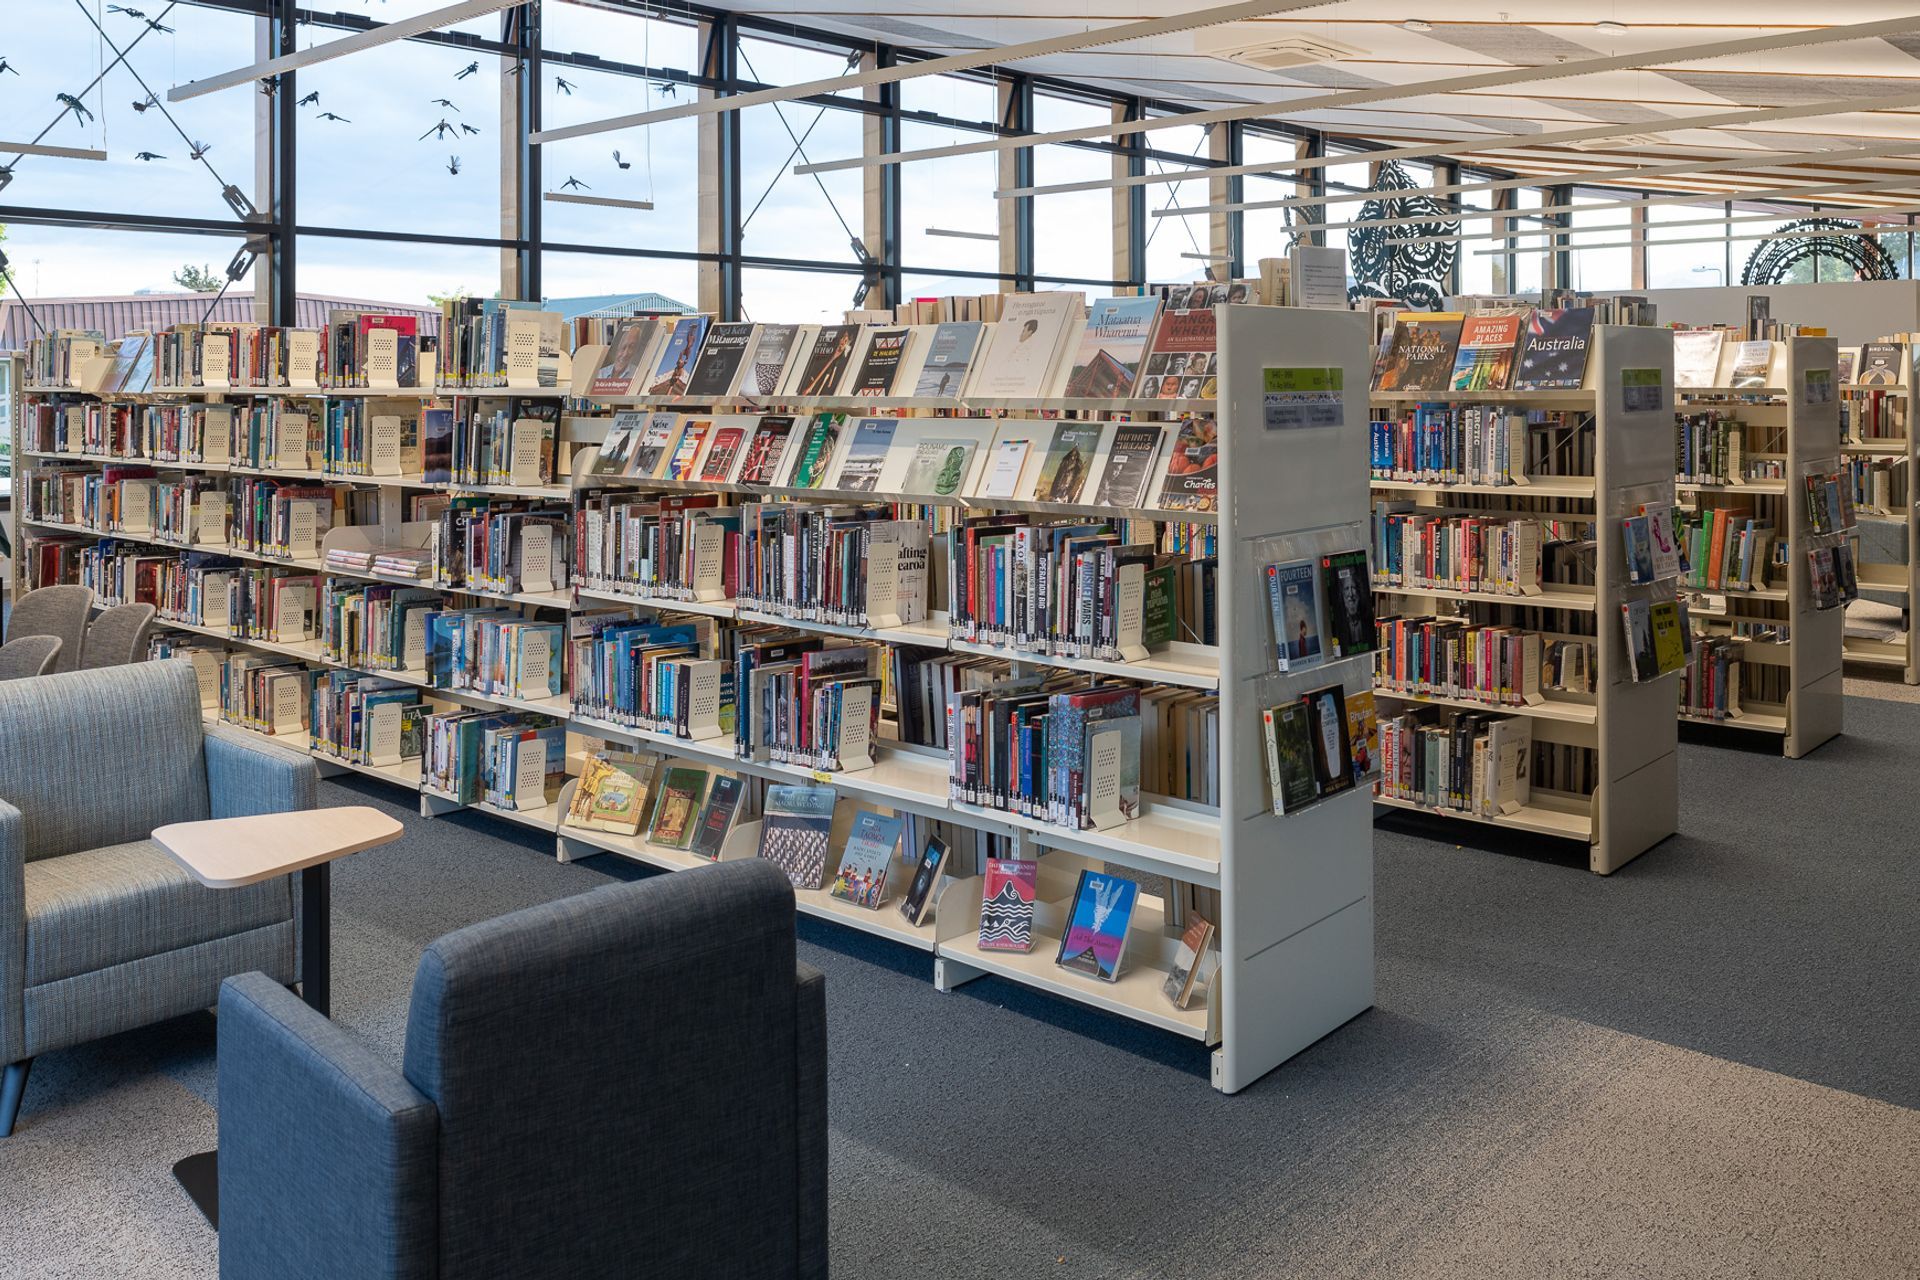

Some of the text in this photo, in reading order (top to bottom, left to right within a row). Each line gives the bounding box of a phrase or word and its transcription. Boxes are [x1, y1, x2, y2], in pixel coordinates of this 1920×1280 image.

[1097, 314, 1142, 326] Mataatua
[1173, 315, 1216, 324] TANGA
[1095, 324, 1139, 338] Wharenui
[1170, 325, 1216, 336] WHENU
[1473, 325, 1508, 334] AMAZING
[1476, 333, 1503, 342] PLACES
[1527, 335, 1585, 351] Australia
[1399, 345, 1446, 353] NATIONAL
[1405, 352, 1436, 361] PARKS
[1184, 478, 1216, 490] Charles
[455, 517, 467, 526] CH
[898, 547, 927, 560] afting
[897, 560, 925, 571] earoa
[1038, 557, 1047, 597] OPERATION
[1280, 566, 1313, 581] FOURTEEN
[1082, 561, 1094, 625] MUSKET WARS
[1269, 576, 1280, 612] OURTEEN
[402, 708, 422, 720] UTA
